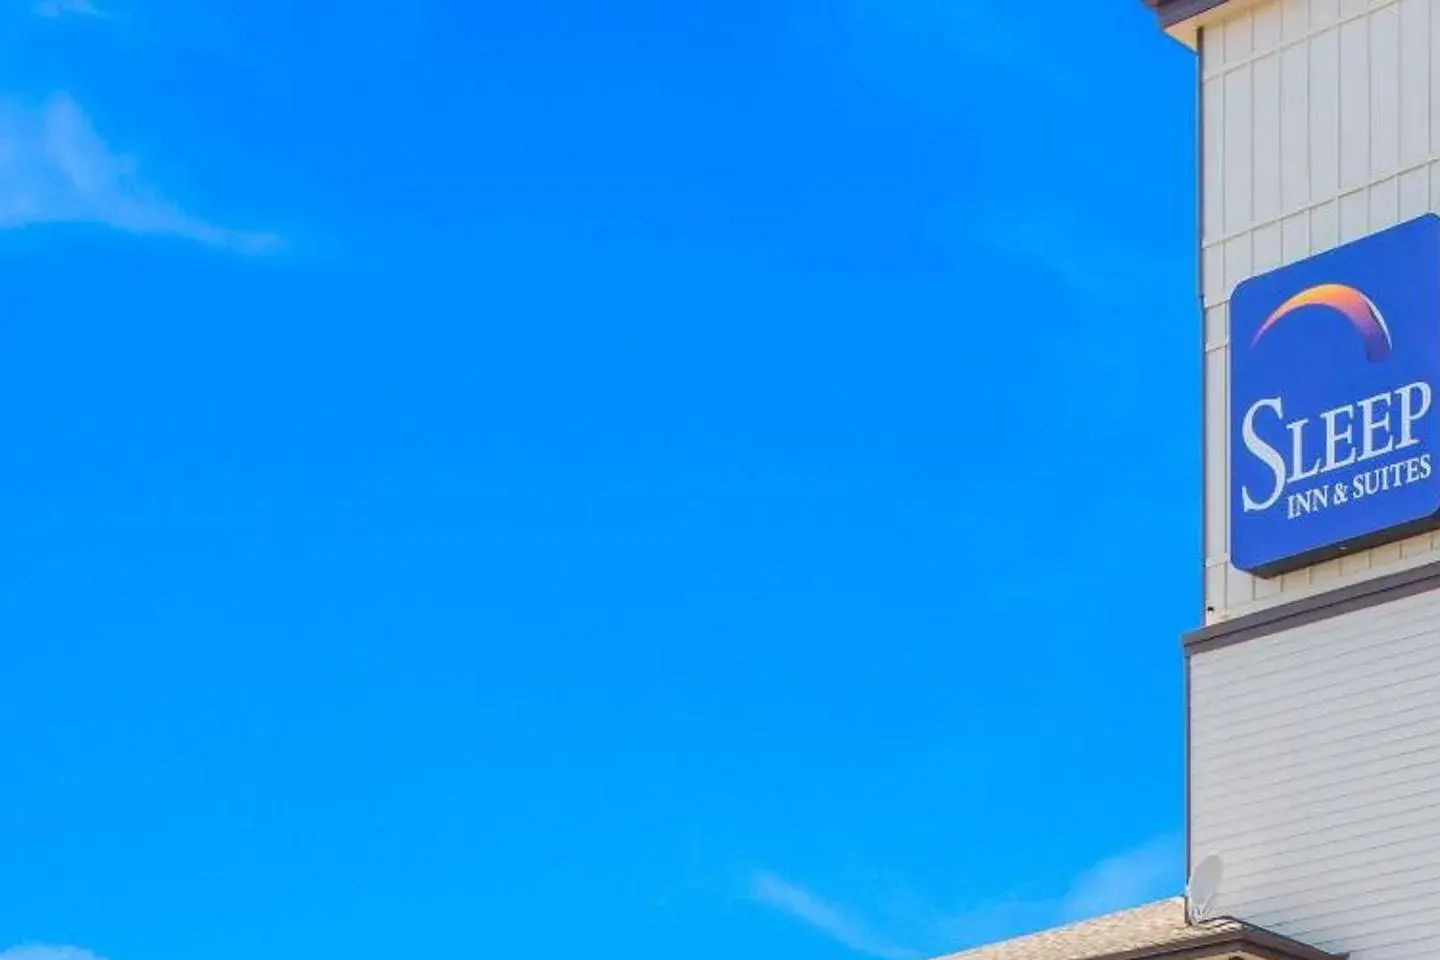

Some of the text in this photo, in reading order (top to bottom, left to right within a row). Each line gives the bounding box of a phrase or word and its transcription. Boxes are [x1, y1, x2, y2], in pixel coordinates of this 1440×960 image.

[1241, 381, 1432, 513] SLEEP
[1287, 453, 1432, 519] INN & SUITES
